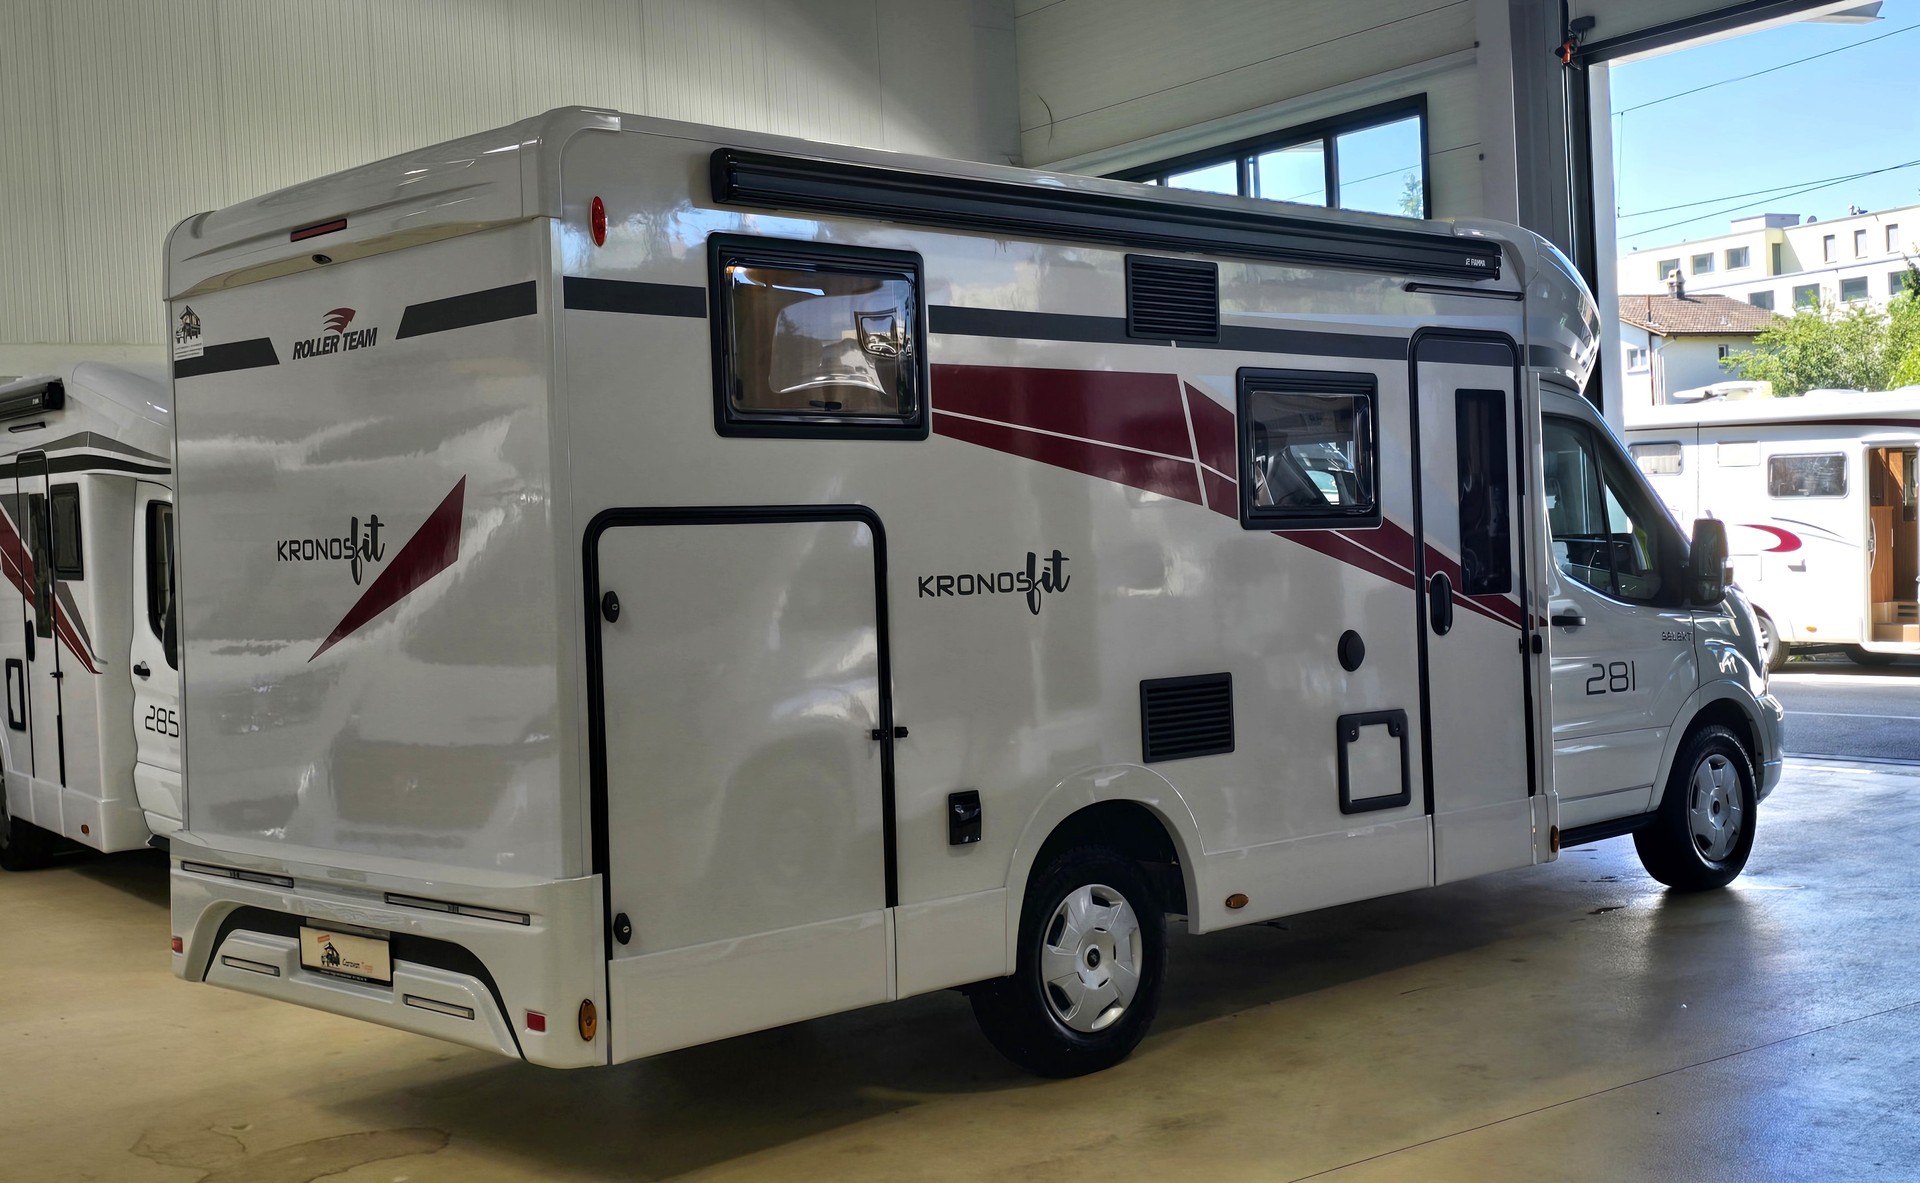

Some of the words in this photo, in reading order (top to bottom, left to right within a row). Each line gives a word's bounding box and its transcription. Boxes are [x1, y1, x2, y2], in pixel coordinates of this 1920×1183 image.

[293, 335, 341, 361] ROLLER
[342, 327, 378, 352] TEAM
[1586, 660, 1636, 696] 281
[144, 704, 179, 738] 285
